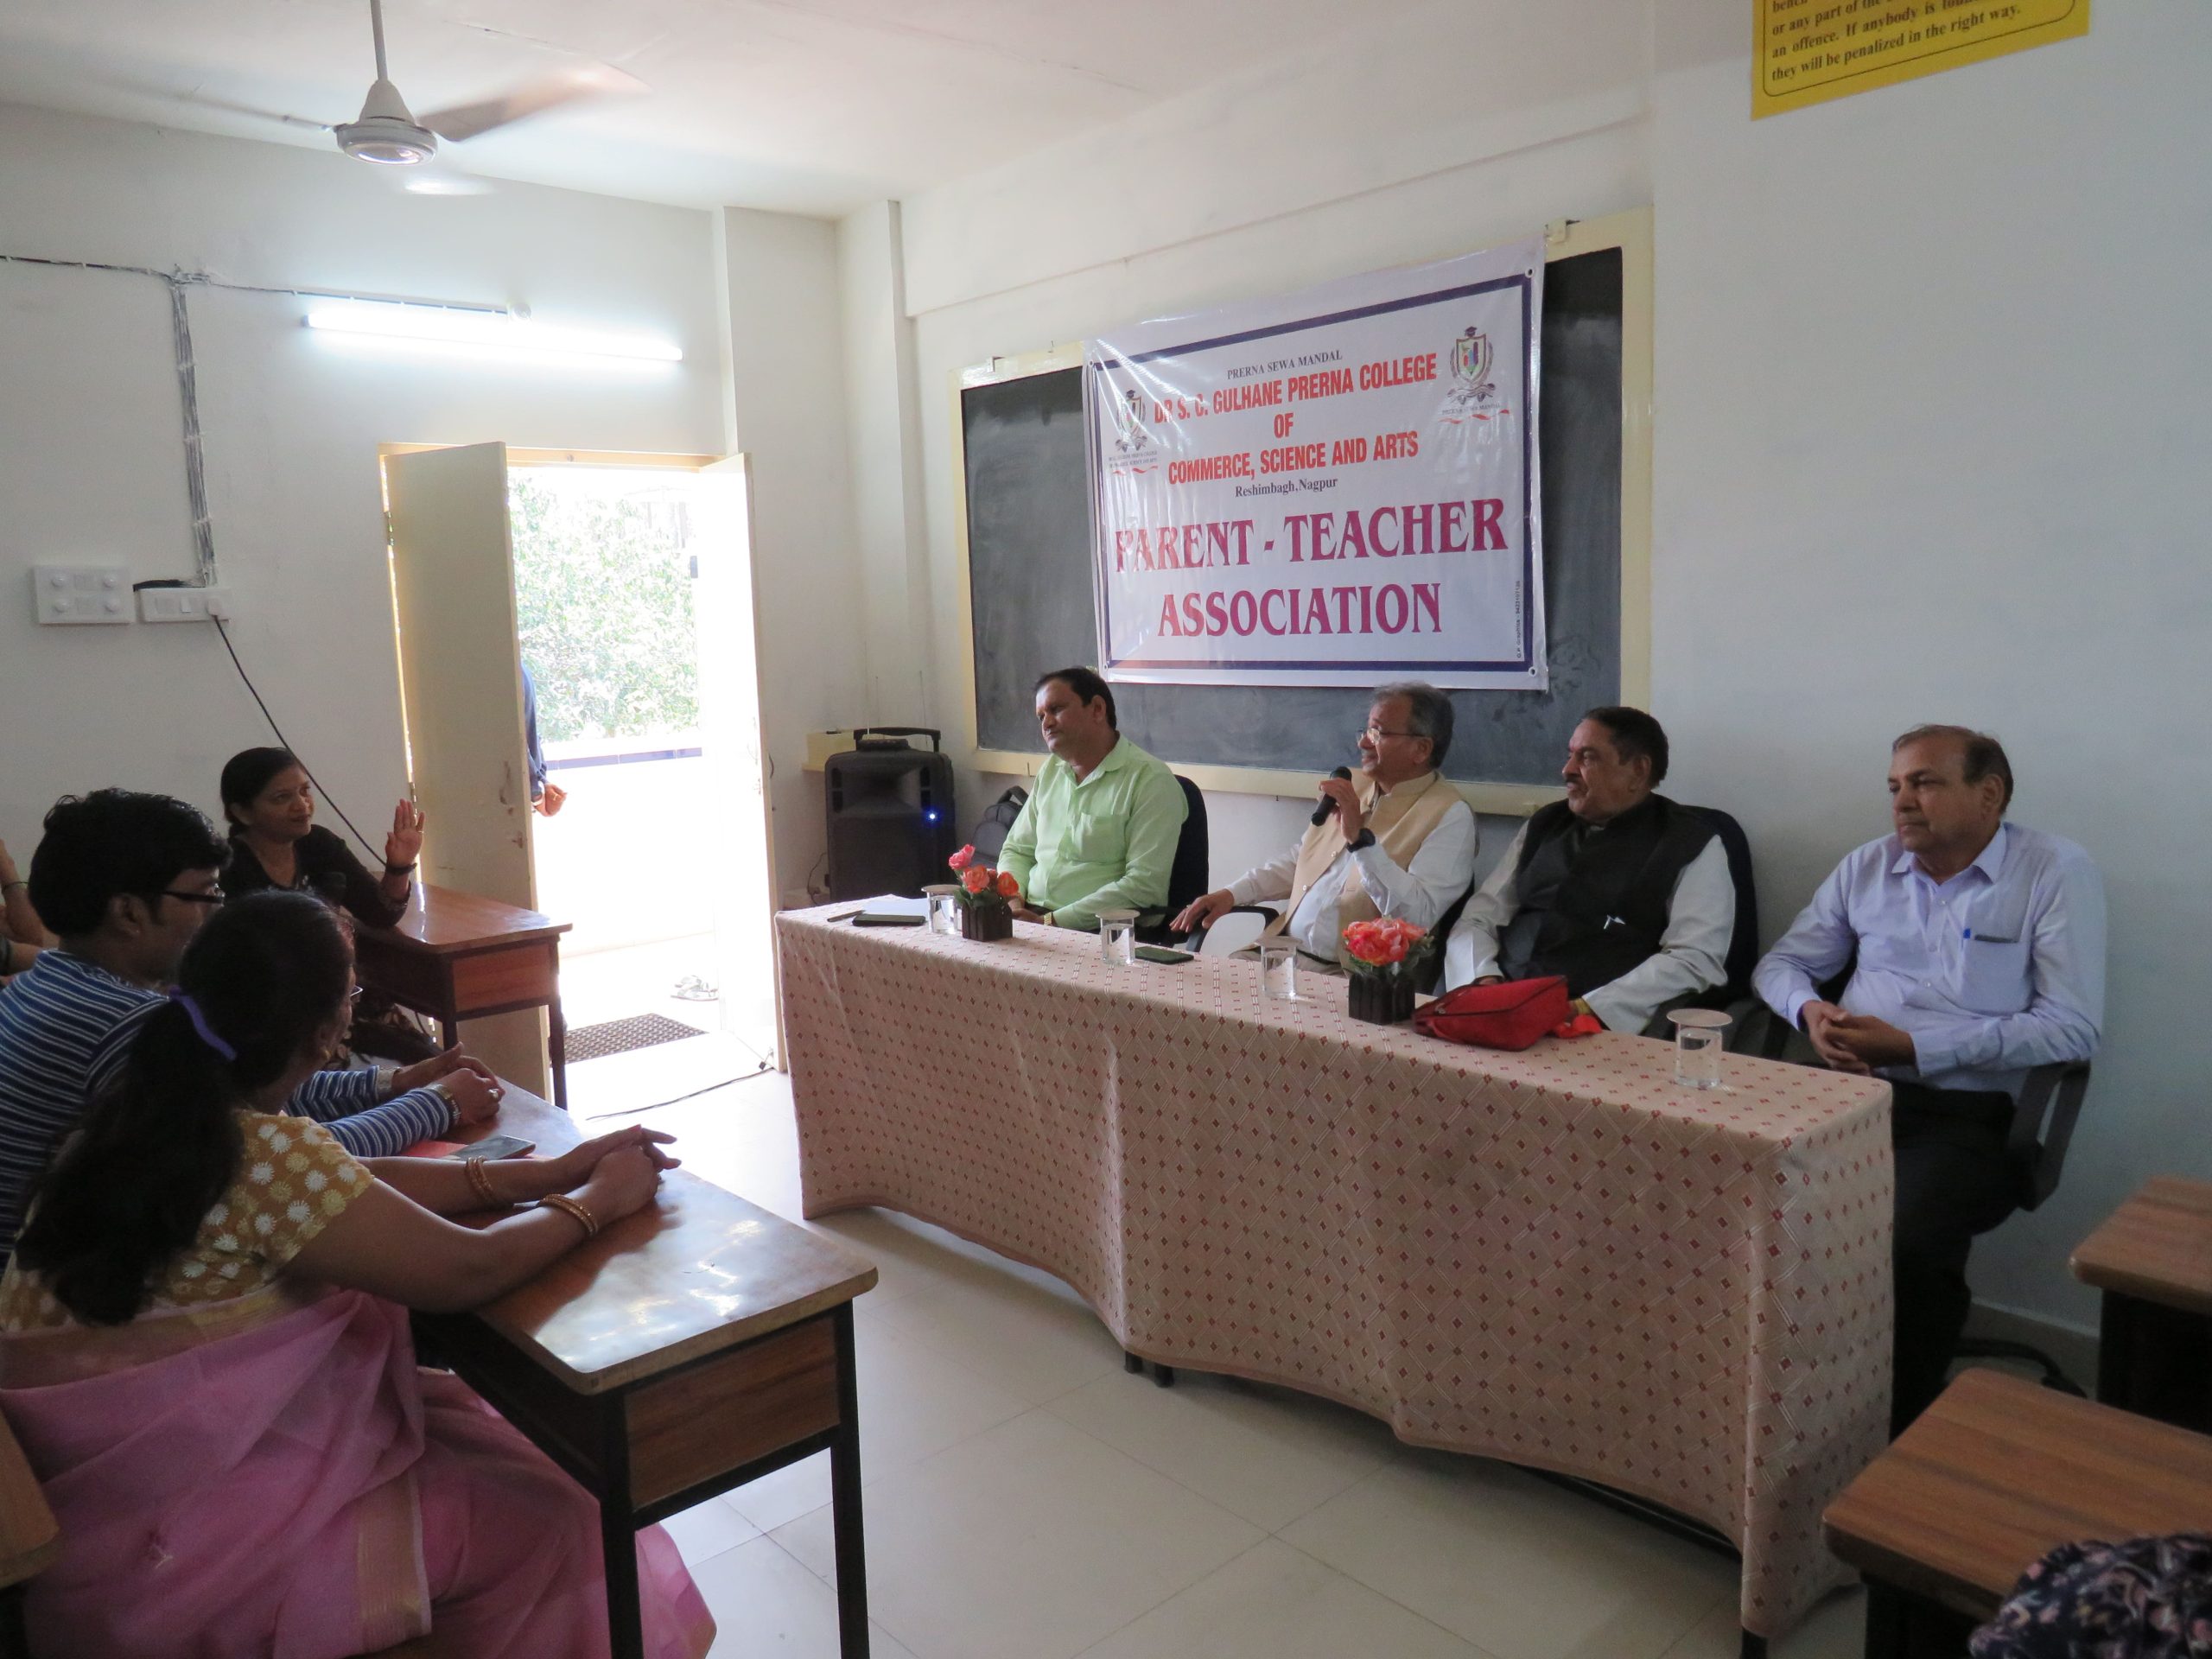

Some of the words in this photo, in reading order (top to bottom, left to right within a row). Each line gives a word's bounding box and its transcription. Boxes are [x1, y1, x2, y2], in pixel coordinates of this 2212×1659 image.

[1772, 24, 1784, 36] or
[1789, 16, 1809, 30] any
[1815, 6, 1841, 27] part
[1845, 0, 1858, 14] of
[1772, 47, 1786, 59] an
[1792, 32, 1840, 53] offence.
[1846, 22, 1857, 36] If
[1862, 7, 1916, 32] anybody
[1925, 2, 1935, 15] is
[1772, 66, 1796, 81] they
[1801, 55, 1822, 72] will
[1826, 53, 1840, 67] be
[1844, 33, 1904, 65] penalized
[1909, 30, 1921, 43] in
[1925, 22, 1945, 39] the
[1950, 12, 1985, 33] right
[1989, 4, 2020, 20] way.
[1178, 397, 1190, 420] S.
[1194, 393, 1208, 416] C.
[1213, 379, 1282, 413] GULHANE
[1287, 367, 1354, 403] PRERNA
[1359, 353, 1437, 391] COLLEGE
[1227, 365, 1264, 380] PRERNA
[1267, 359, 1295, 373] SEWA
[1298, 349, 1343, 368] MANDAL
[1274, 412, 1294, 439] OF
[1168, 452, 1255, 486] COMMERCE,
[1260, 442, 1326, 474] SCIENCE
[1332, 437, 1367, 466] AND
[1373, 430, 1419, 461] ARTS
[1116, 519, 1254, 572] PARENT
[1263, 541, 1274, 552] -
[1282, 498, 1509, 563] TEACHER
[1158, 582, 1442, 638] ASSOCIATION
